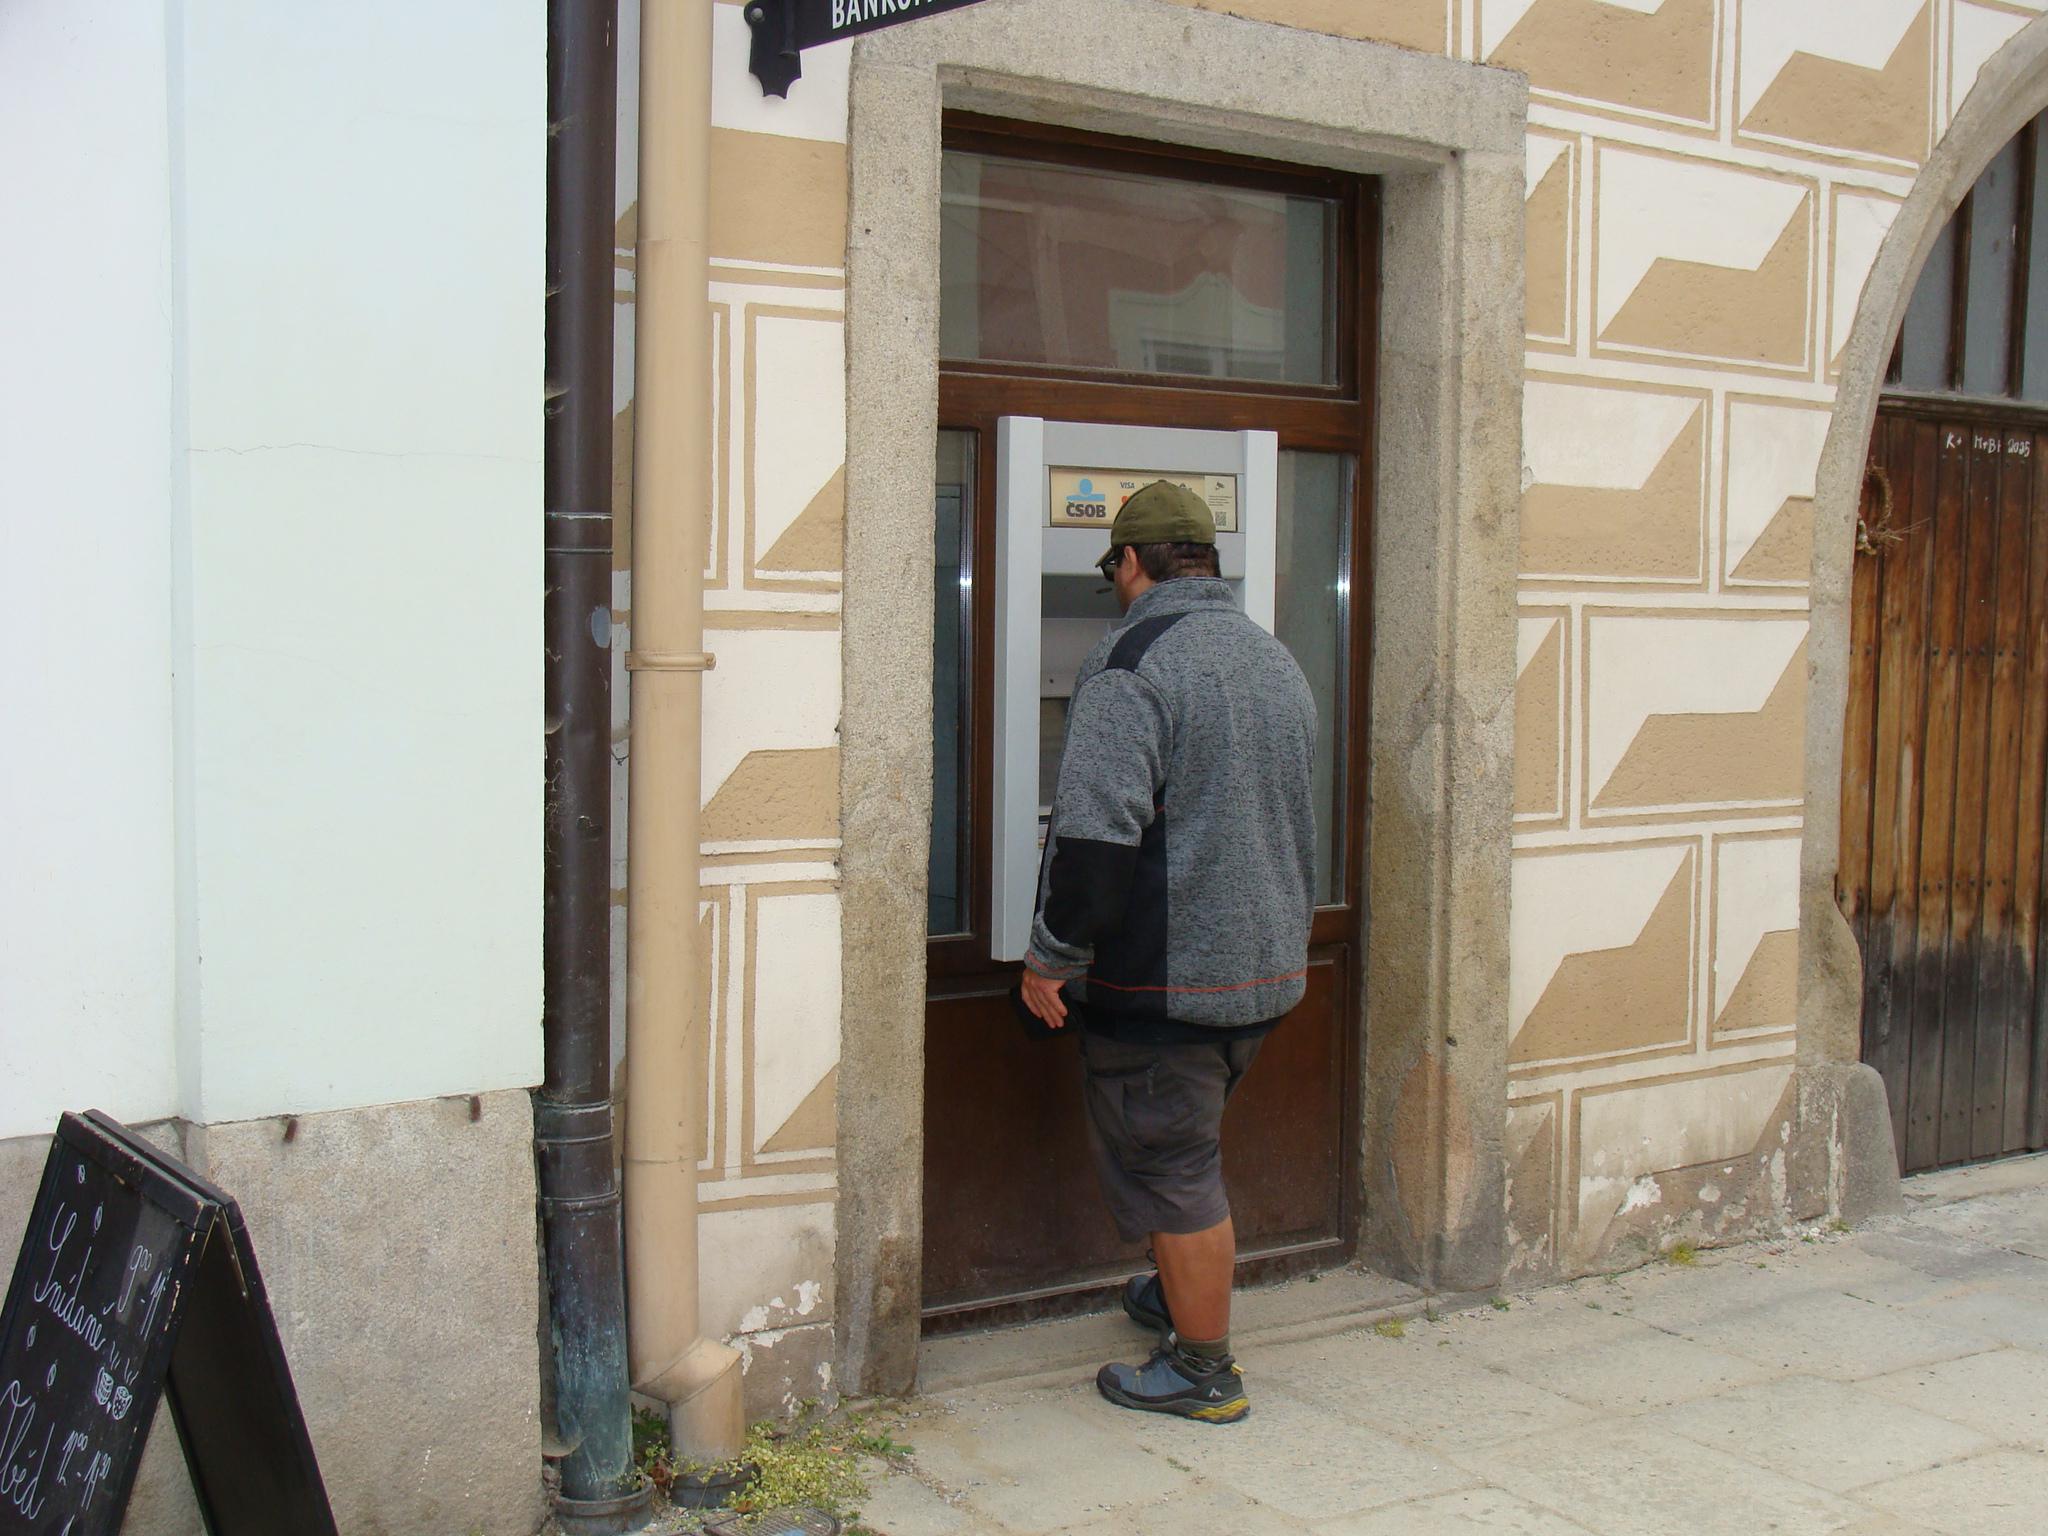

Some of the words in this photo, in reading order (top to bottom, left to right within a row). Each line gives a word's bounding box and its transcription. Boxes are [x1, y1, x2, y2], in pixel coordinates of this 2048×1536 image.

[832, 0, 936, 29] BANK
[1120, 481, 1135, 489] VISA
[1066, 501, 1106, 518] ČSOB
